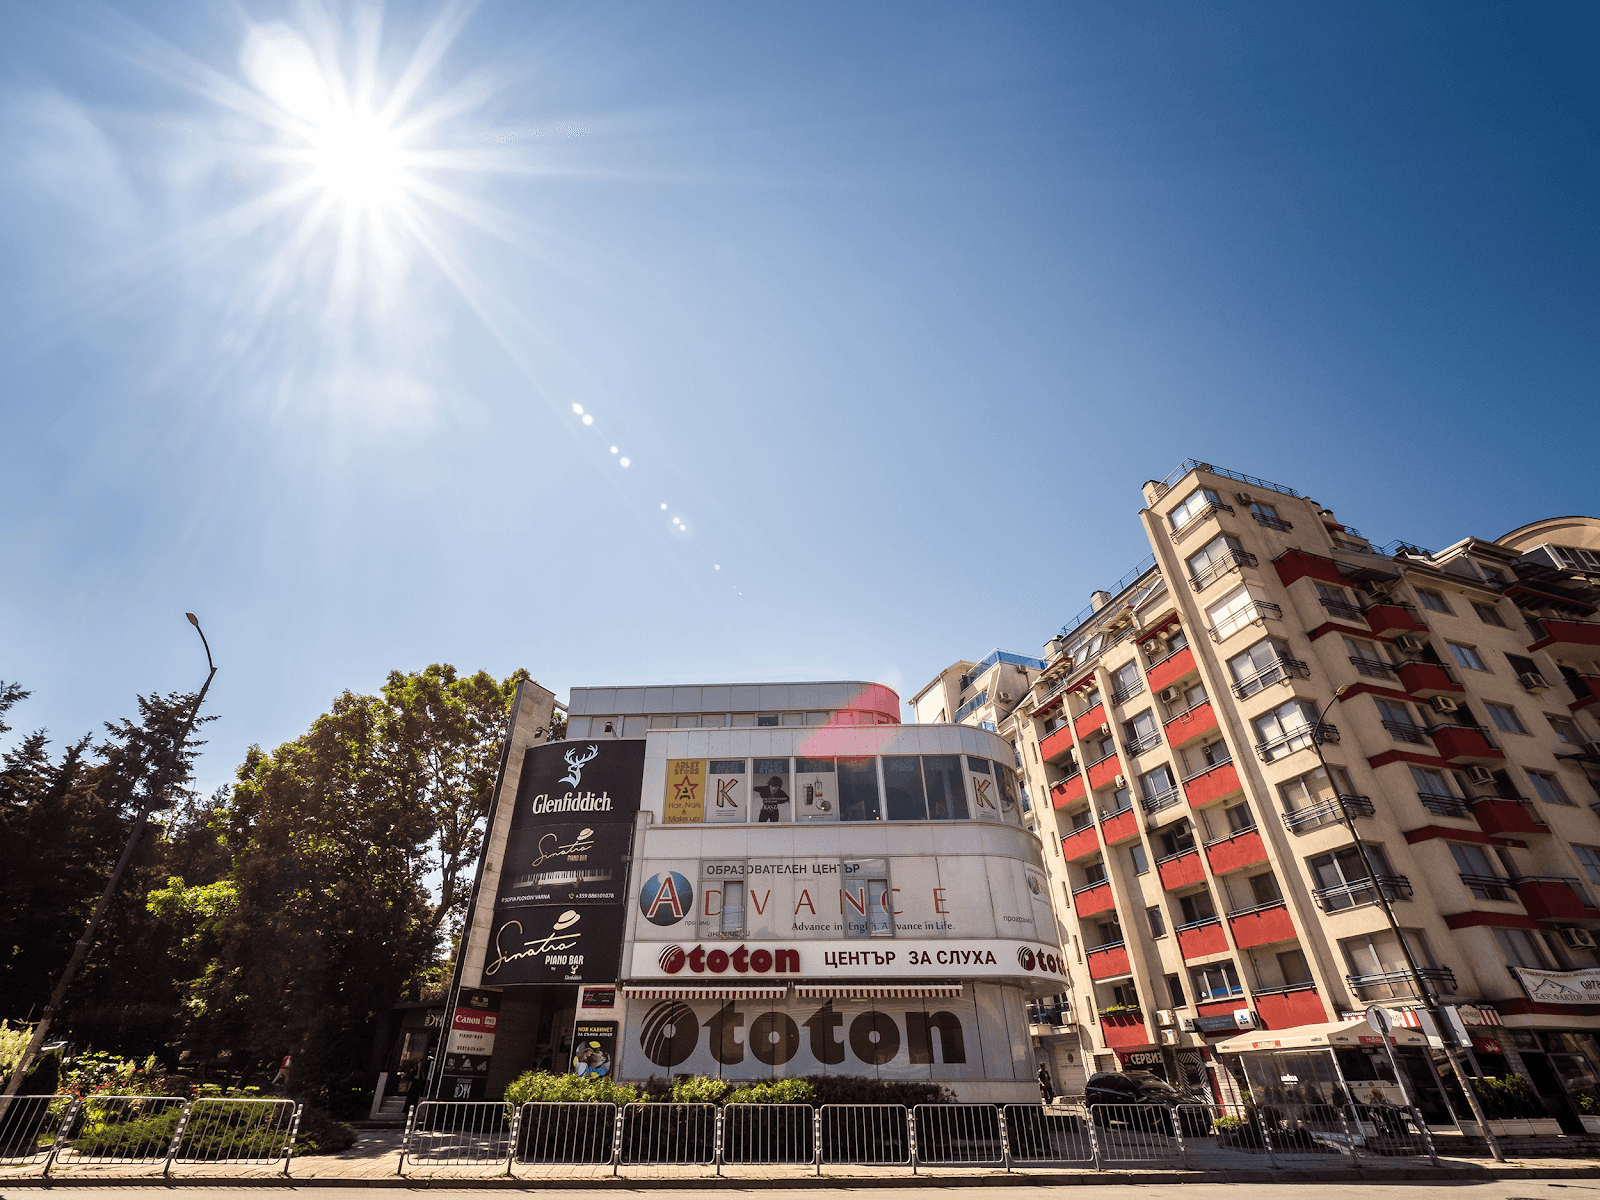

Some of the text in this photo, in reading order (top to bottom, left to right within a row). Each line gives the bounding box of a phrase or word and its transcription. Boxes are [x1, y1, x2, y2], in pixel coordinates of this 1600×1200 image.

[532, 791, 612, 815] Glenfiddich
[681, 808, 687, 816] &
[532, 833, 594, 867] Sinatra
[792, 921, 831, 932] Advance
[834, 922, 843, 931] in
[881, 921, 923, 931] Avance
[925, 921, 934, 930] in
[936, 921, 956, 931] Life.
[485, 920, 582, 976] Sinatra
[544, 954, 584, 965] PIANO BAR
[824, 950, 997, 968] ЦЕНТЪР ЗА СЛУХА
[455, 1014, 481, 1025] Canon
[1130, 1051, 1164, 1065] СЕРВИЗ
